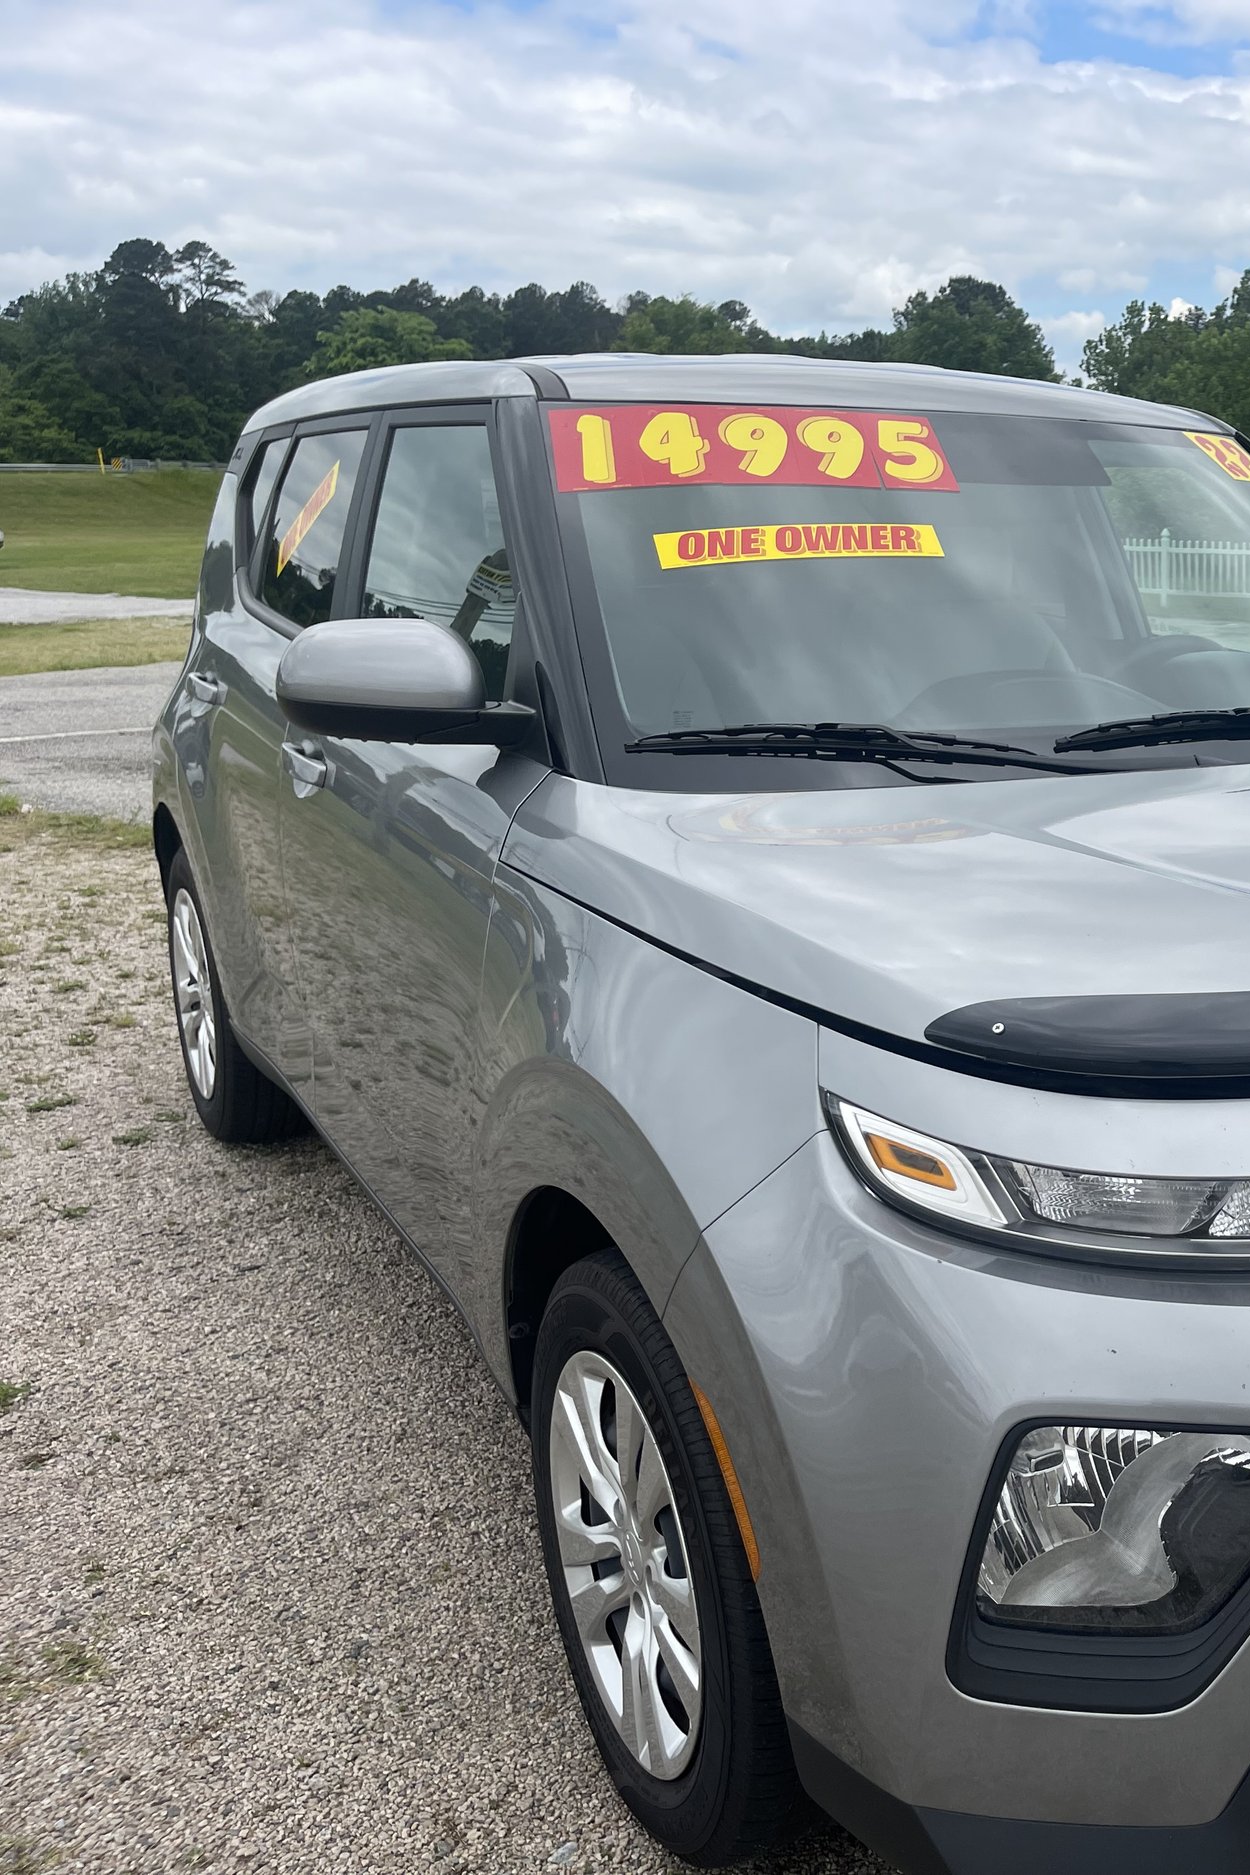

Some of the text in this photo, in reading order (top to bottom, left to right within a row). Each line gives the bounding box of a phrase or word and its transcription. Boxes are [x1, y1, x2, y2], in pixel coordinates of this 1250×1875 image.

[576, 411, 945, 484] 14995
[677, 525, 923, 562] ONE OWNER
